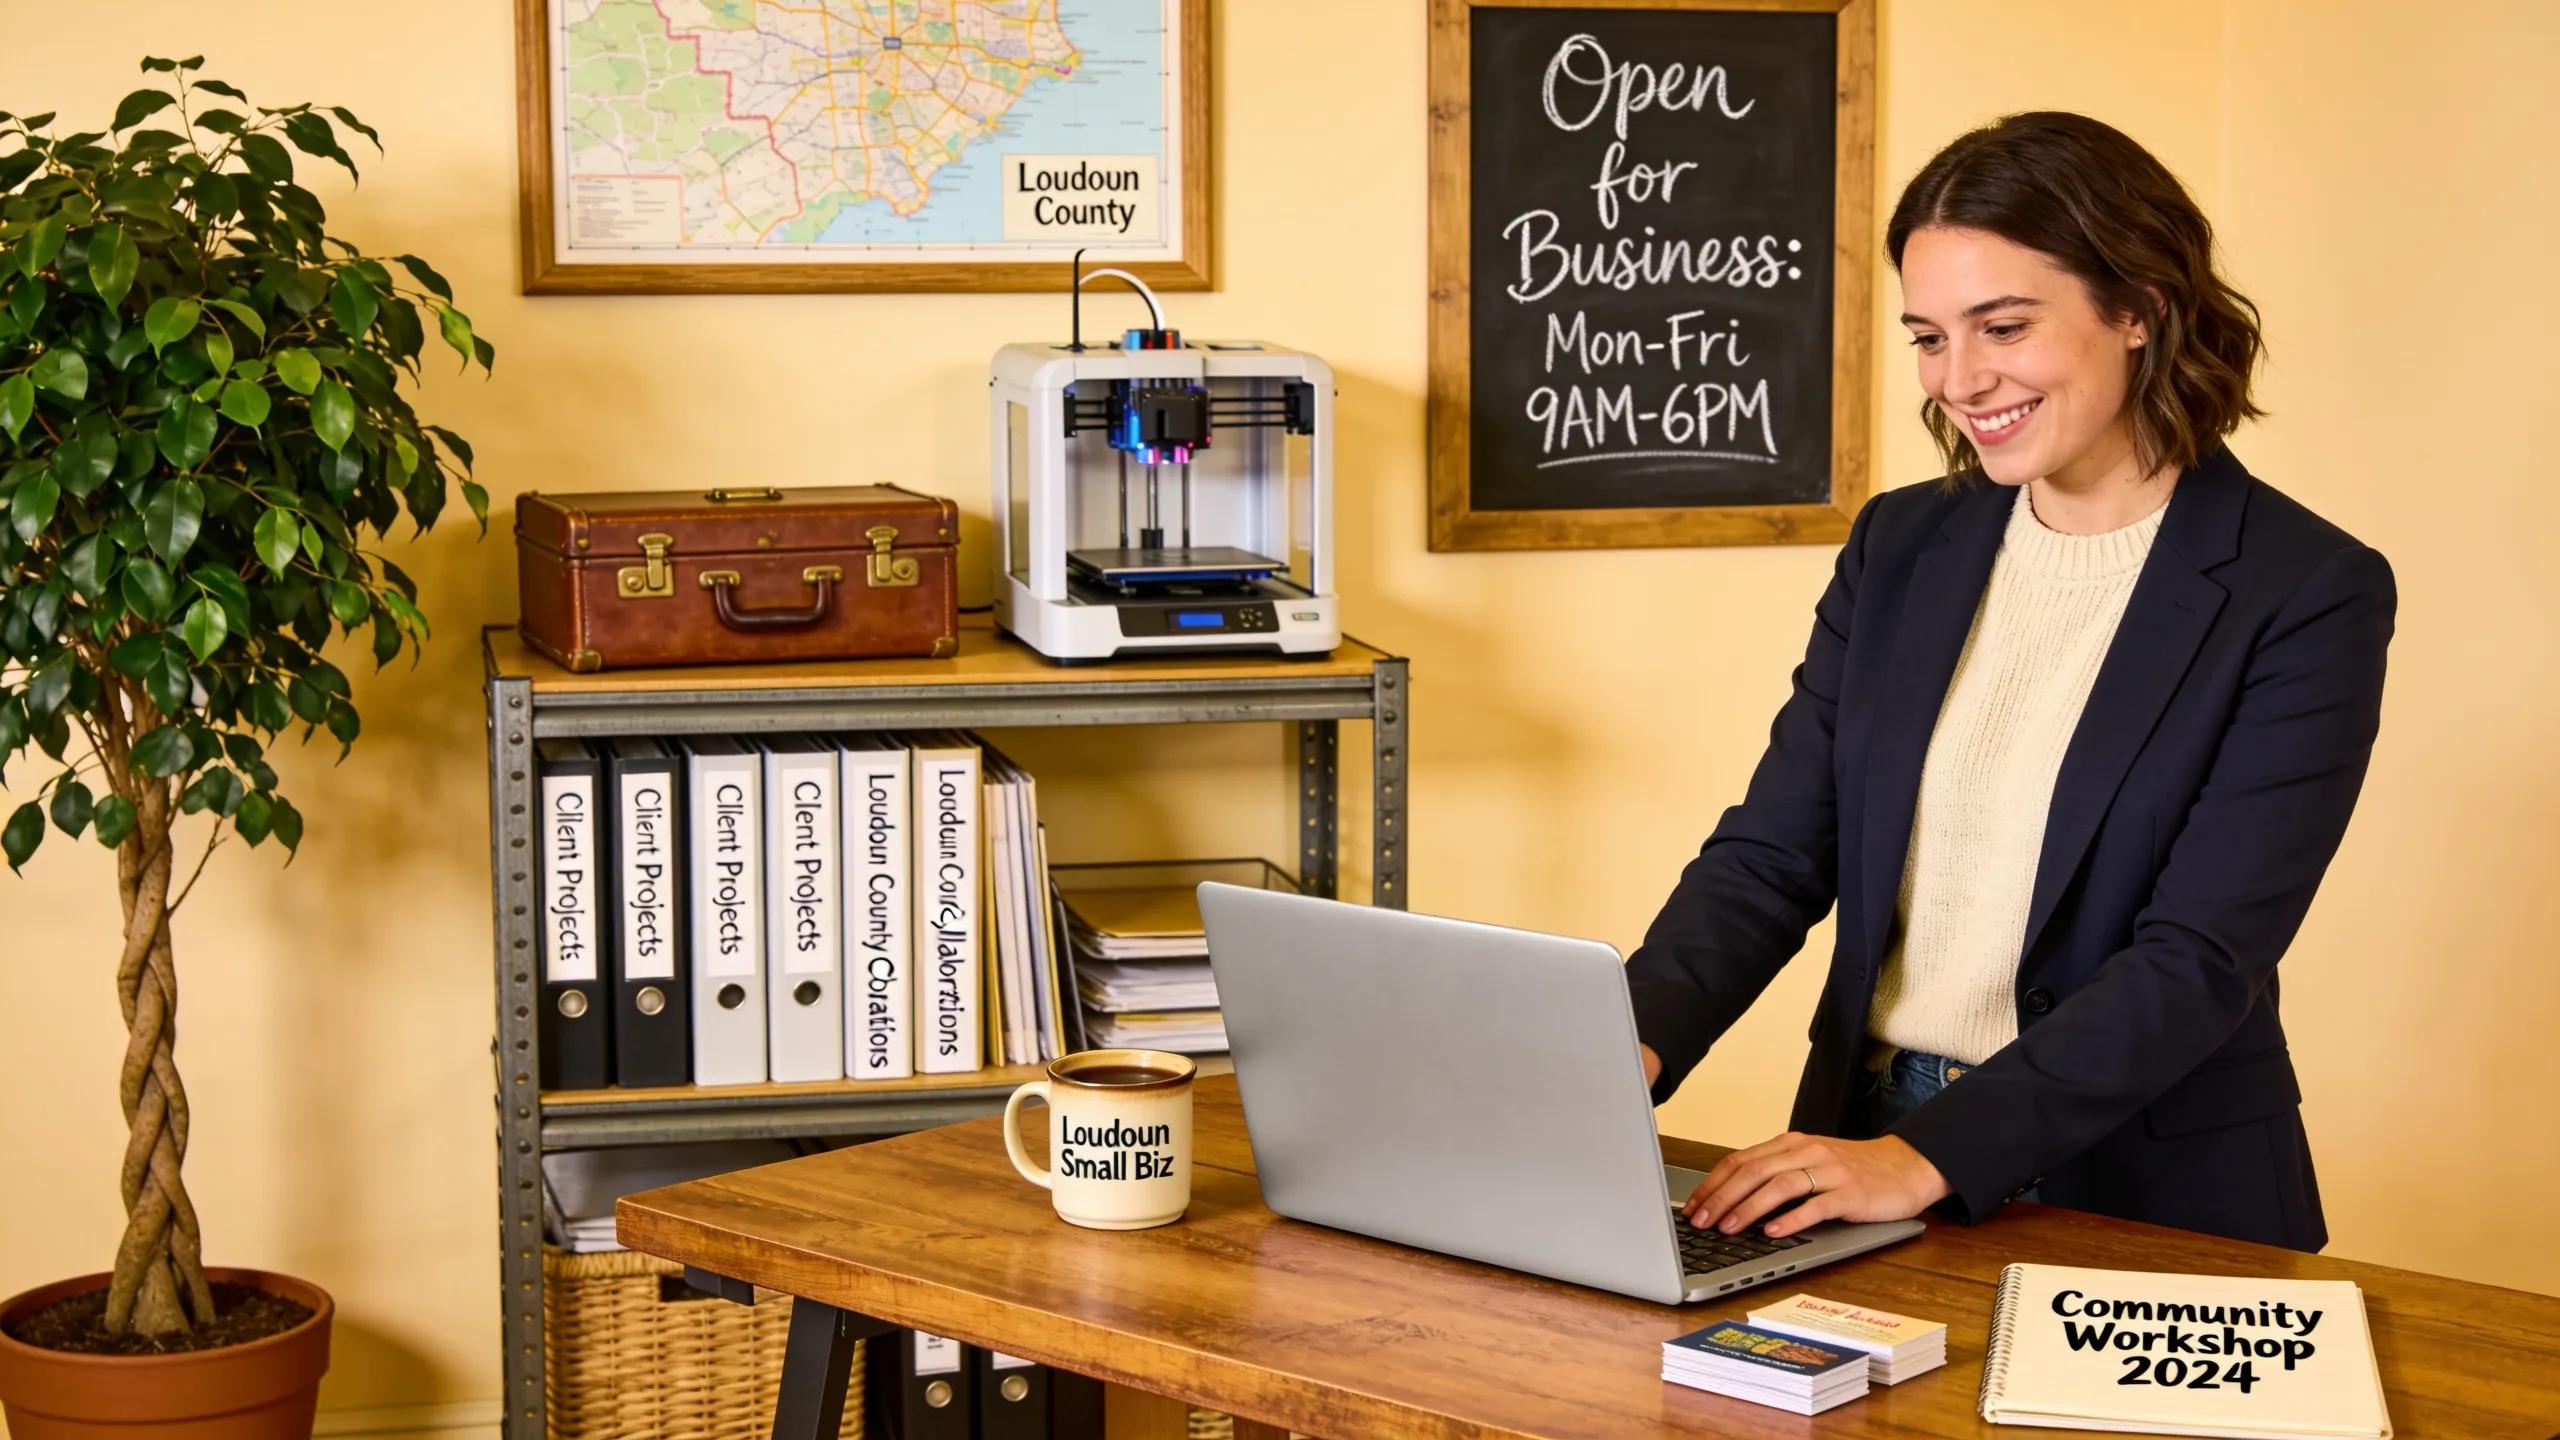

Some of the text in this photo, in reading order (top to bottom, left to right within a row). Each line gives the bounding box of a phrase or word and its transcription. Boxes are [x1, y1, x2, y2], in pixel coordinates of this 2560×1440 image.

[1543, 33, 1756, 140] Open
[1019, 160, 1140, 193] Loudoun
[1590, 141, 1698, 229] for
[1034, 196, 1137, 233] County
[1502, 209, 1802, 303] Business:
[1545, 310, 1750, 375] Mon-Fri
[1526, 378, 1778, 455] 9AM-6PM
[629, 787, 665, 957] Client Projects
[789, 858, 823, 952] Projects
[712, 861, 746, 956] Projects
[862, 873, 896, 952] County
[1060, 1148, 1175, 1181] Small Biz
[1062, 1115, 1171, 1148] Loudoun
[2051, 1290, 2324, 1336] Community
[2062, 1321, 2316, 1371] Workshop
[2116, 1355, 2261, 1395] 2024
